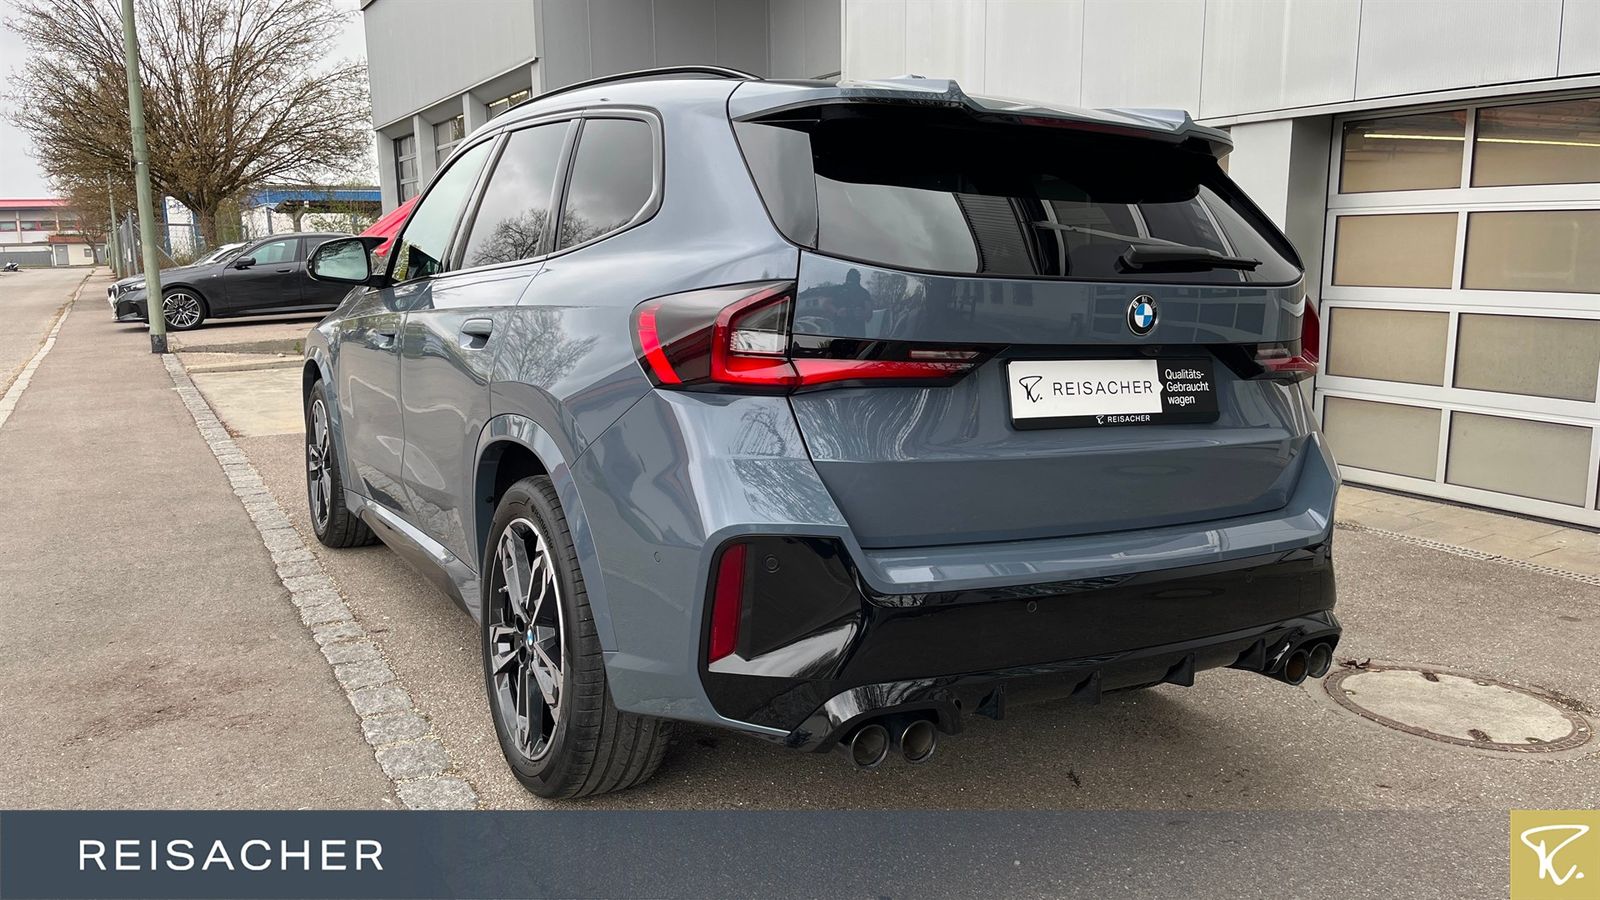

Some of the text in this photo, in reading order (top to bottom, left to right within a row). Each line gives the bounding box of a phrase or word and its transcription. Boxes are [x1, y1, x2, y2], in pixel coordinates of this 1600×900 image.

[1132, 296, 1157, 309] BMW
[1165, 369, 1204, 380] Qualitäts-
[1053, 381, 1153, 396] REISACHER
[1166, 381, 1210, 392] Gebraucht
[1167, 396, 1196, 407] wagen
[1107, 414, 1151, 423] REISACHER
